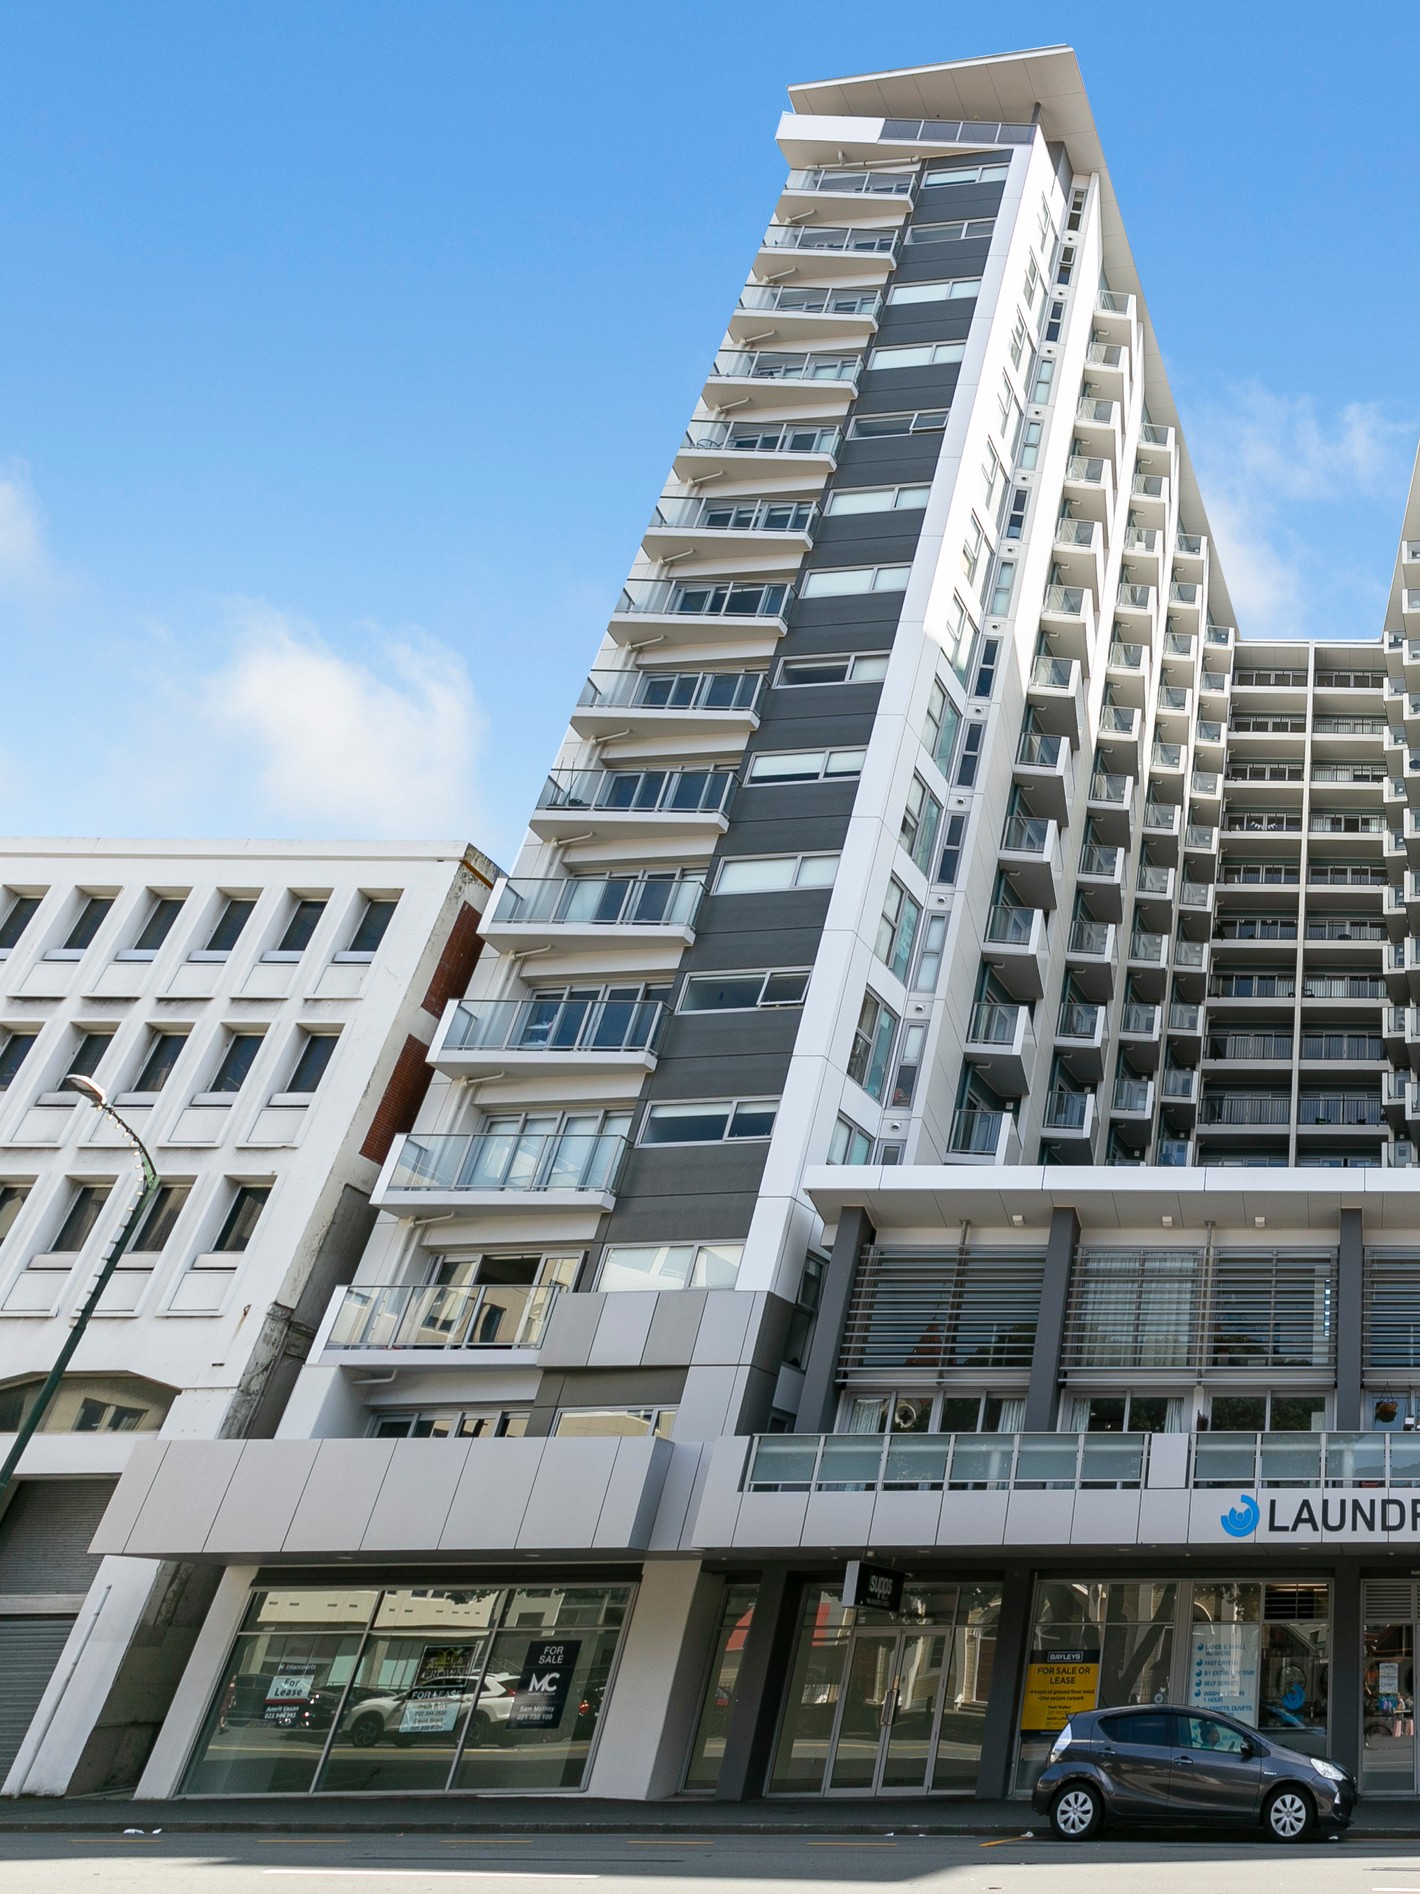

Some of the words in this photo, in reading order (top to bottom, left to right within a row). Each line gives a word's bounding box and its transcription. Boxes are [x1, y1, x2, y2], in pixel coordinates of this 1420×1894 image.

[544, 1646, 564, 1655] FOR
[539, 1655, 564, 1664] SALE
[284, 1679, 300, 1687] For
[528, 1672, 560, 1692] MC
[275, 1688, 302, 1697] Lease
[411, 1690, 431, 1699] FOR
